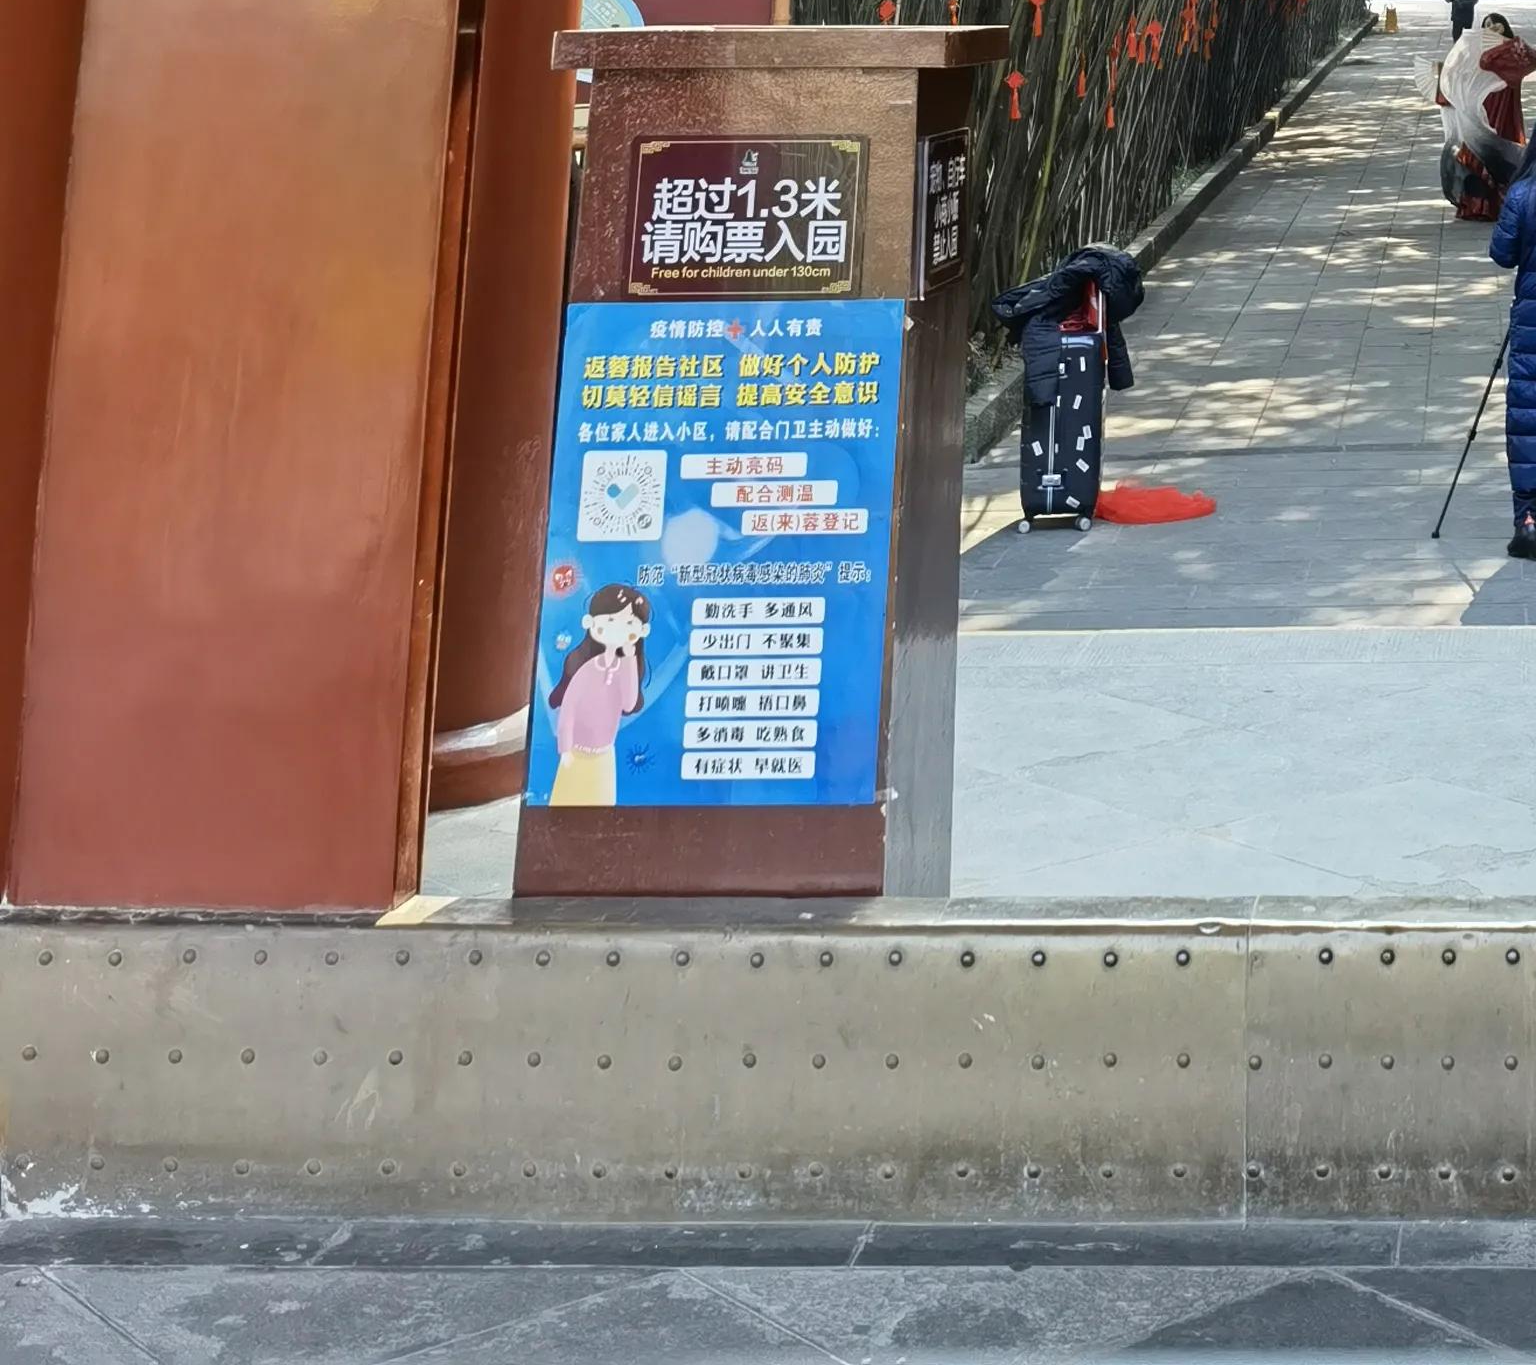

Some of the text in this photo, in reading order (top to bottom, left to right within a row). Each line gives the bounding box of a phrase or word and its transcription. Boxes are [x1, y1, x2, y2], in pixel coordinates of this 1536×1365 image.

[652, 176, 842, 221] 超过1.3米
[641, 220, 848, 264] 请购票入园
[651, 265, 831, 279] Free for children under 130cm
[650, 317, 823, 339] 疫情防控 人人有责
[583, 352, 881, 380] 返蓉报告社区 做好个人防护
[581, 381, 880, 409] 切莫轻信谣言 提高安全意识
[706, 456, 784, 476] 主动亮码
[736, 483, 814, 504] 配合测温
[705, 601, 813, 619] 勤洗手 多通风
[702, 633, 811, 650] 少出门 不聚集
[700, 664, 809, 681] 戴口罩 讲卫生
[697, 725, 806, 742] 多消毒 吃熟食
[694, 757, 803, 774] 有症状 早就医
